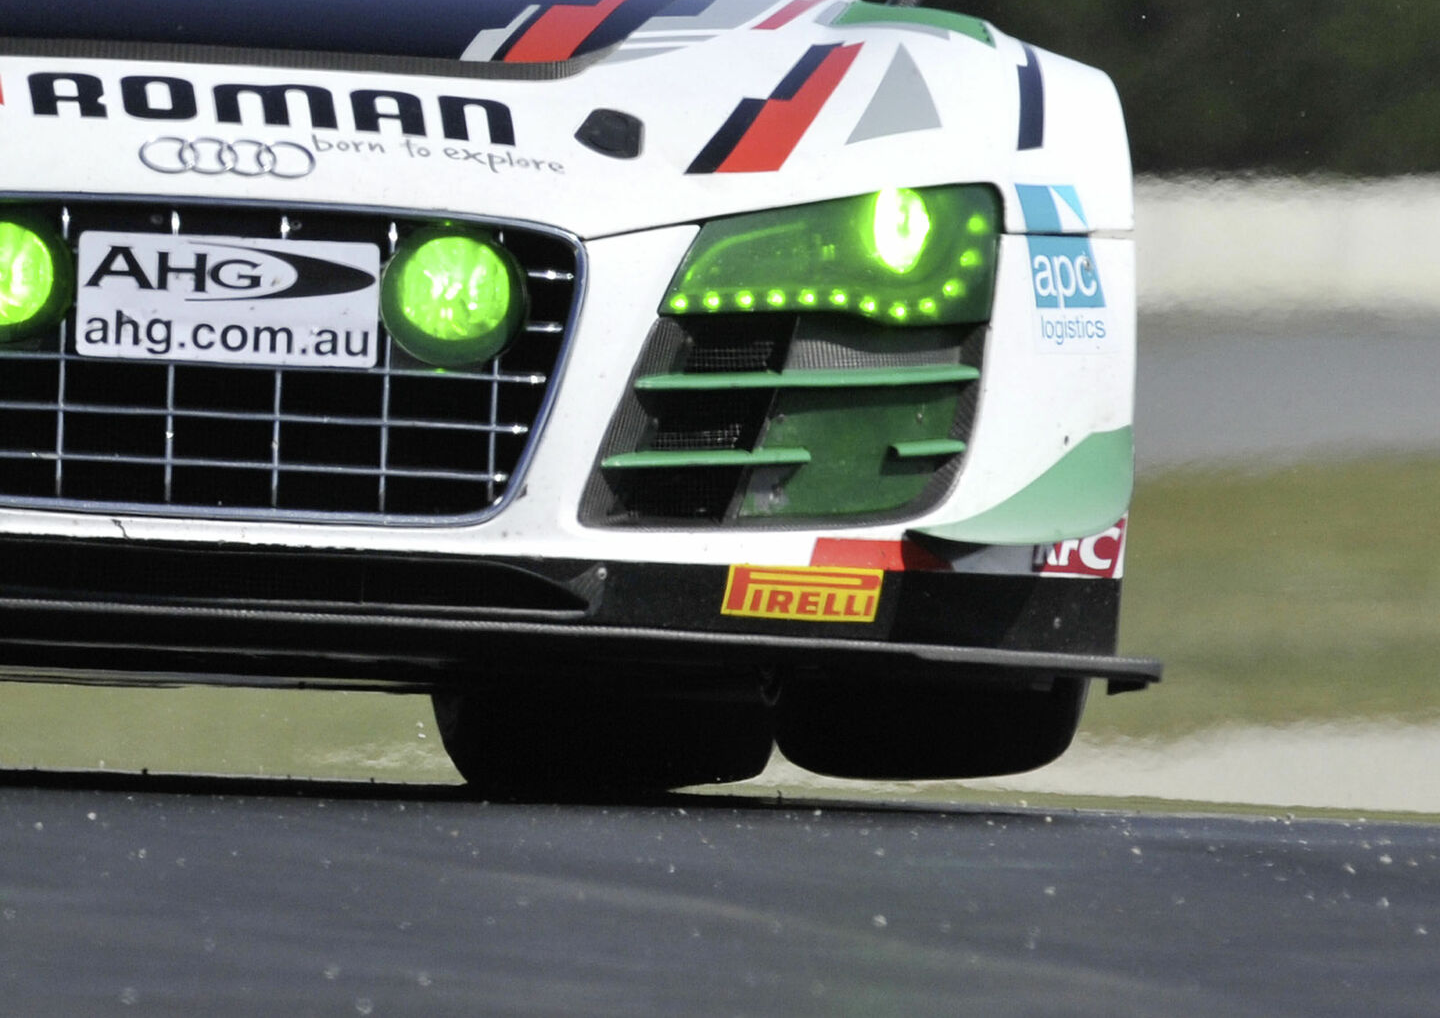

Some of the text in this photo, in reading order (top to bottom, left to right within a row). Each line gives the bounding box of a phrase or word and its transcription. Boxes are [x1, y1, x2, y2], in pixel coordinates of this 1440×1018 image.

[27, 71, 515, 146] ROMAN
[312, 135, 563, 173] born to explore
[83, 245, 262, 293] AHG
[1033, 254, 1098, 309] apc
[84, 310, 369, 355] ahg.com.au
[1040, 315, 1106, 345] logistics
[726, 567, 881, 617] PIRELLI
